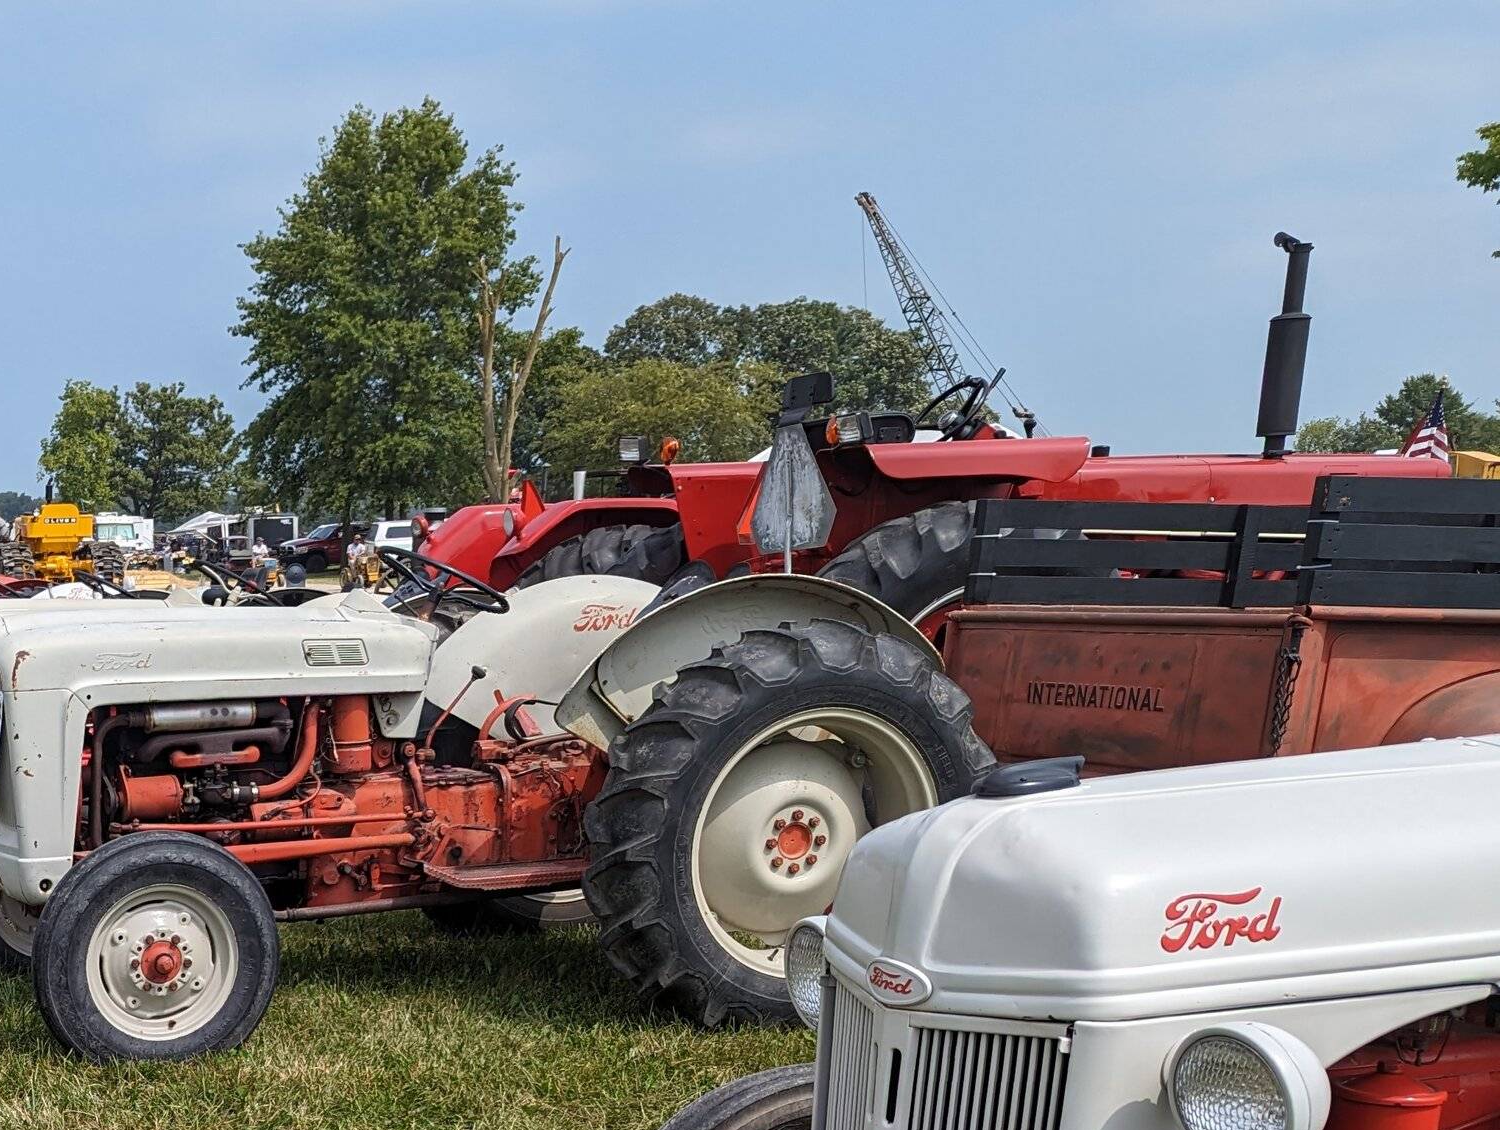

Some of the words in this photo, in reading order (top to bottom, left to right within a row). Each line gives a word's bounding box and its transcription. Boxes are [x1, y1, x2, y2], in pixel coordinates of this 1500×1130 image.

[573, 604, 637, 632] Ford
[92, 652, 153, 671] Ford
[1027, 681, 1165, 713] INTERNATIONAL
[1160, 887, 1282, 954] Ford
[869, 966, 913, 995] Ford
